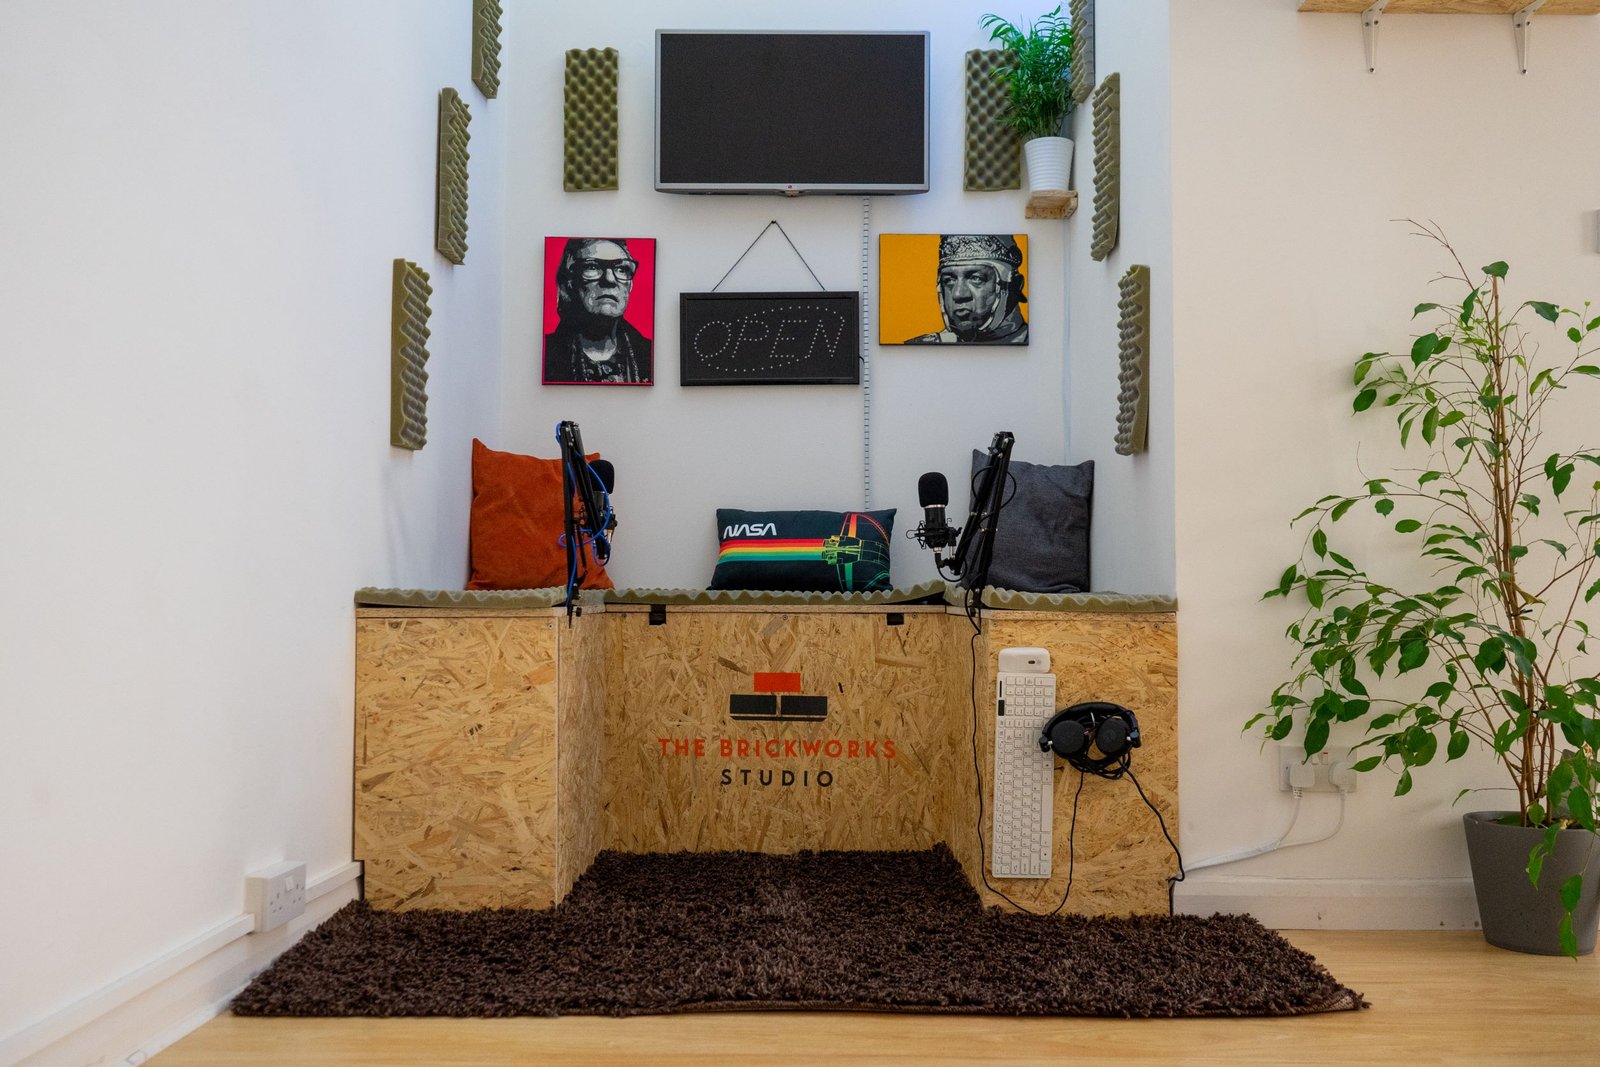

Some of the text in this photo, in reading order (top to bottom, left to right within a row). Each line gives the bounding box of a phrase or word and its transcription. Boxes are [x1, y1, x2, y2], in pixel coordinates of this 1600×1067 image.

[694, 319, 845, 359] OPEN
[723, 523, 777, 539] NASA
[658, 738, 897, 759] THE BRICKWORKS
[721, 769, 833, 787] STUDIO
